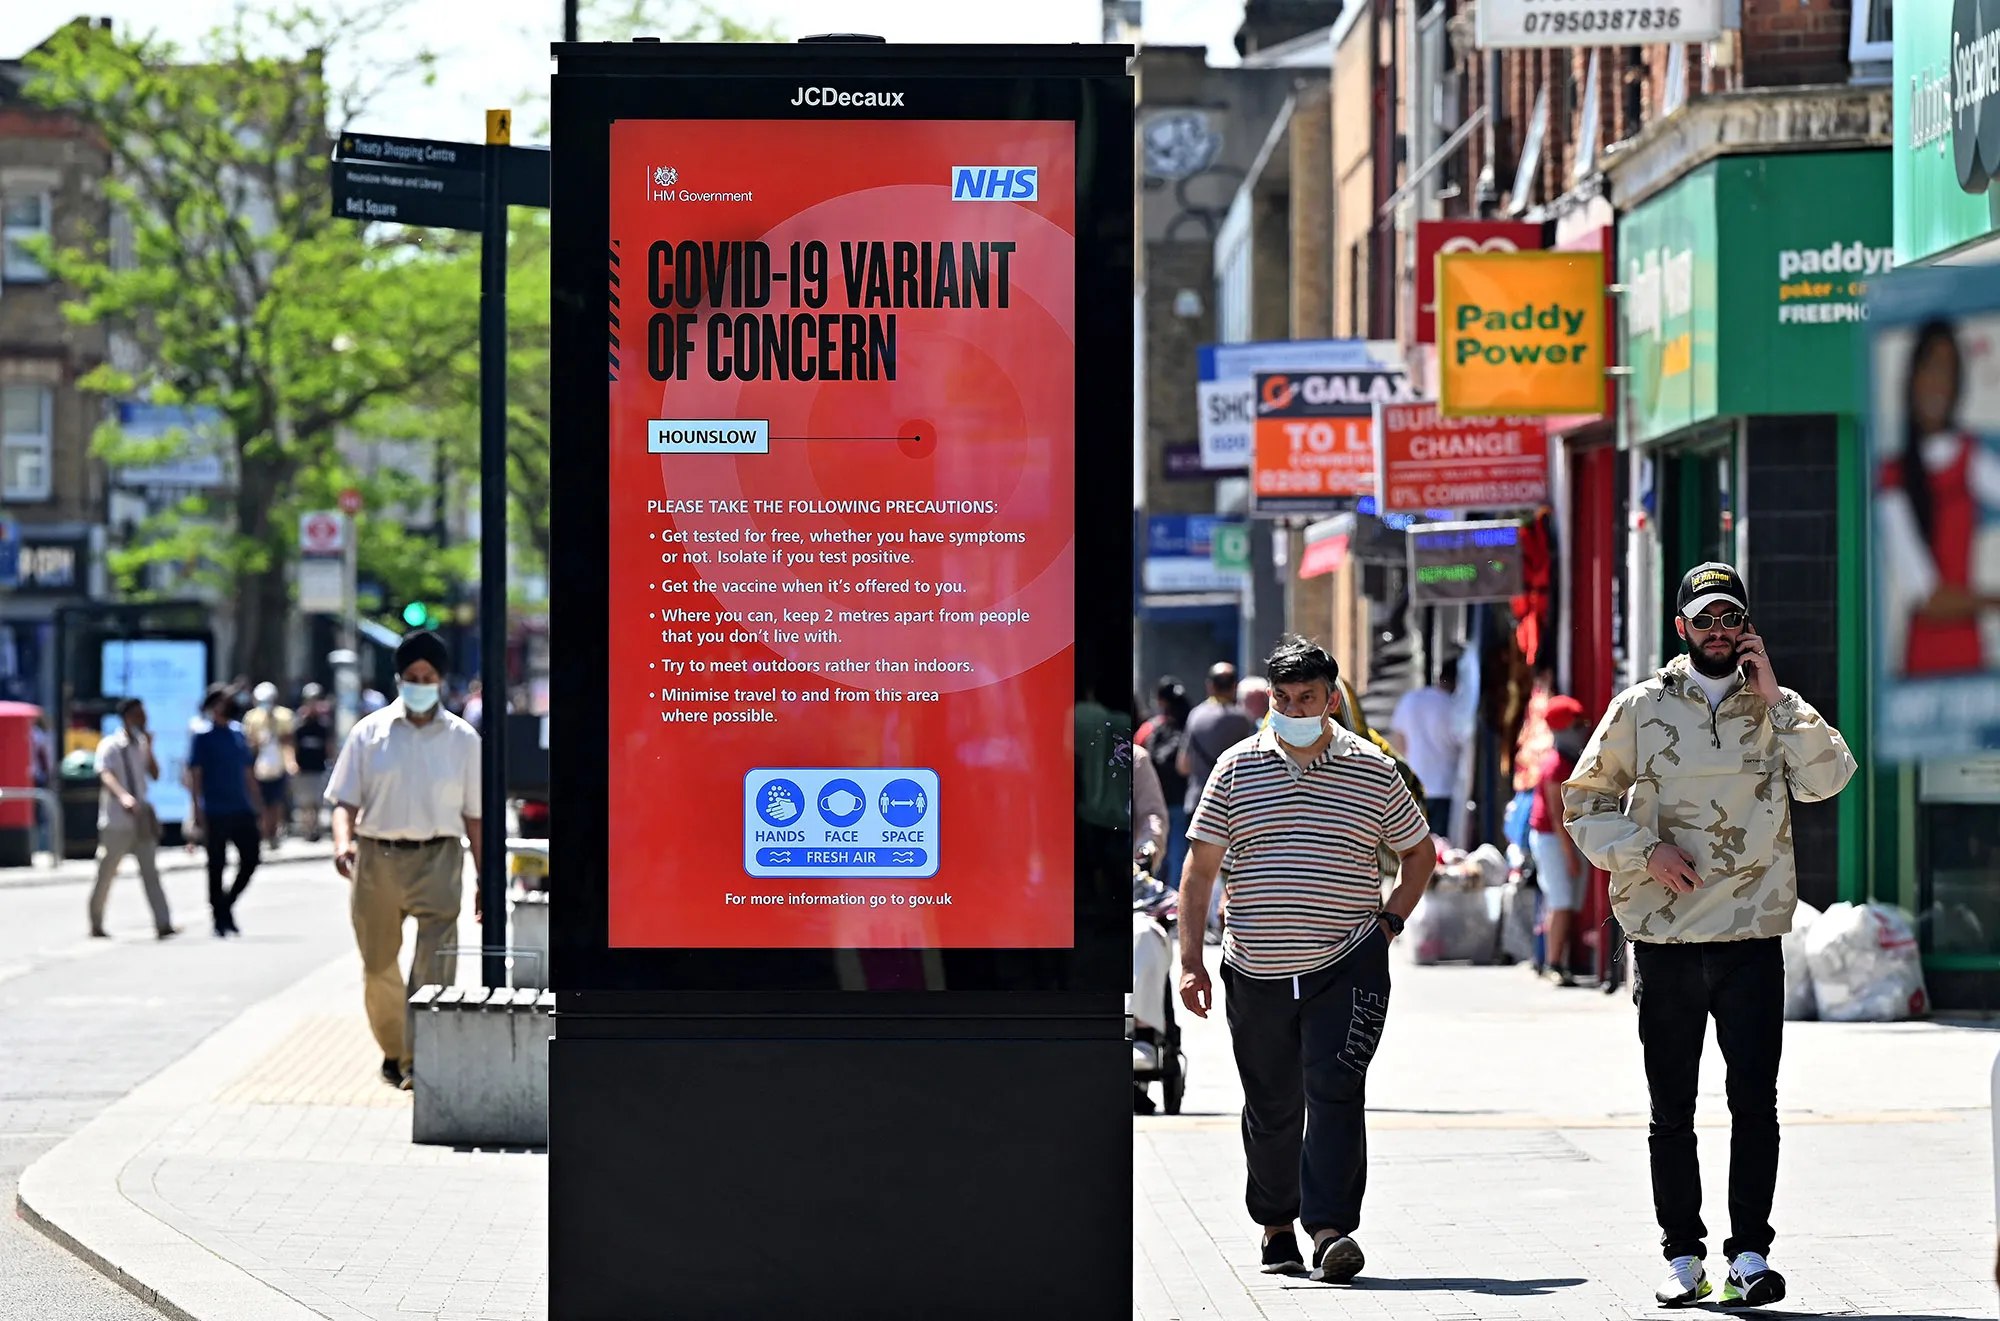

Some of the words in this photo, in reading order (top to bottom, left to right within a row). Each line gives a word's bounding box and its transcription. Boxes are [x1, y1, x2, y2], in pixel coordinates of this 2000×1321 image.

[1523, 7, 1680, 34] 07950387836
[790, 86, 905, 107] JCDecaux
[354, 138, 382, 158] Treaty
[383, 141, 424, 162] Shopping
[425, 145, 456, 163] Centre
[419, 178, 444, 192] Library
[954, 169, 1036, 199] NHS
[653, 190, 675, 202] HM
[678, 189, 753, 202] Government
[346, 198, 364, 212] Bell
[365, 200, 397, 217] Square
[647, 240, 828, 309] COVID-19
[840, 240, 1016, 309] VARIANT
[1779, 280, 1833, 302] poker
[1456, 302, 1586, 337] Paddy
[647, 312, 698, 382] OF
[706, 312, 897, 382] CONCERN
[1456, 338, 1588, 367] Power
[658, 429, 758, 445] HOUNSLOW
[1283, 422, 1335, 452] TO
[1409, 430, 1522, 460] CHANGE
[1421, 480, 1547, 505] COMMISSION
[647, 499, 704, 513] PLEASE
[708, 500, 749, 514] TAKE
[753, 500, 784, 513] THE
[788, 500, 881, 514] FOLLOWING
[886, 500, 998, 514] PRECAUTIONS:
[661, 529, 689, 543] Get
[692, 528, 739, 543] tested
[743, 528, 767, 543] for
[770, 528, 804, 545] free,
[809, 528, 873, 543] whether
[876, 532, 904, 547] you
[909, 528, 945, 543] have
[948, 530, 1026, 547] symptoms
[661, 553, 678, 563] or
[683, 550, 712, 564] not.
[717, 549, 768, 564] Isolate
[772, 549, 783, 563] if
[786, 553, 814, 567] you
[818, 550, 848, 564] test
[852, 549, 914, 567] positive.
[661, 579, 689, 593] Get
[692, 578, 718, 593] the
[721, 579, 777, 593] vaccine
[781, 578, 823, 593] when
[828, 578, 851, 593] it's
[855, 578, 910, 593] offered
[913, 580, 931, 593] to
[934, 582, 967, 597] you.
[661, 607, 711, 622] Where
[715, 611, 743, 626] you
[747, 611, 778, 625] can,
[783, 607, 820, 626] keep
[824, 608, 834, 622] 2
[838, 609, 890, 623] metres
[893, 609, 935, 626] apart
[938, 607, 975, 623] from
[979, 608, 1030, 626] people
[661, 628, 693, 643] that
[696, 632, 724, 647] you
[729, 628, 769, 643] don't
[774, 628, 800, 643] live
[803, 628, 842, 643] with.
[661, 659, 685, 676] Try
[688, 659, 705, 672] to
[710, 659, 748, 672] meet
[752, 658, 821, 672] outdoors
[825, 658, 871, 672] rather
[874, 658, 909, 672] than
[914, 658, 975, 673] indoors.
[662, 687, 730, 702] Minimise
[733, 687, 776, 702] travel
[780, 689, 797, 702] to
[801, 687, 829, 702] and
[834, 687, 870, 702] from
[874, 687, 902, 702] this
[906, 691, 939, 702] area
[661, 708, 708, 722] where
[713, 708, 778, 726] possible.
[755, 830, 806, 843] HANDS
[824, 830, 859, 843] FACE
[881, 830, 925, 843] SPACE
[806, 851, 849, 864] FRESH
[852, 851, 877, 863] AIR
[725, 893, 747, 905] For
[750, 895, 785, 905] more
[788, 892, 866, 905] information
[869, 895, 887, 908] go
[890, 893, 905, 905] to
[908, 892, 953, 908] gov.uk
